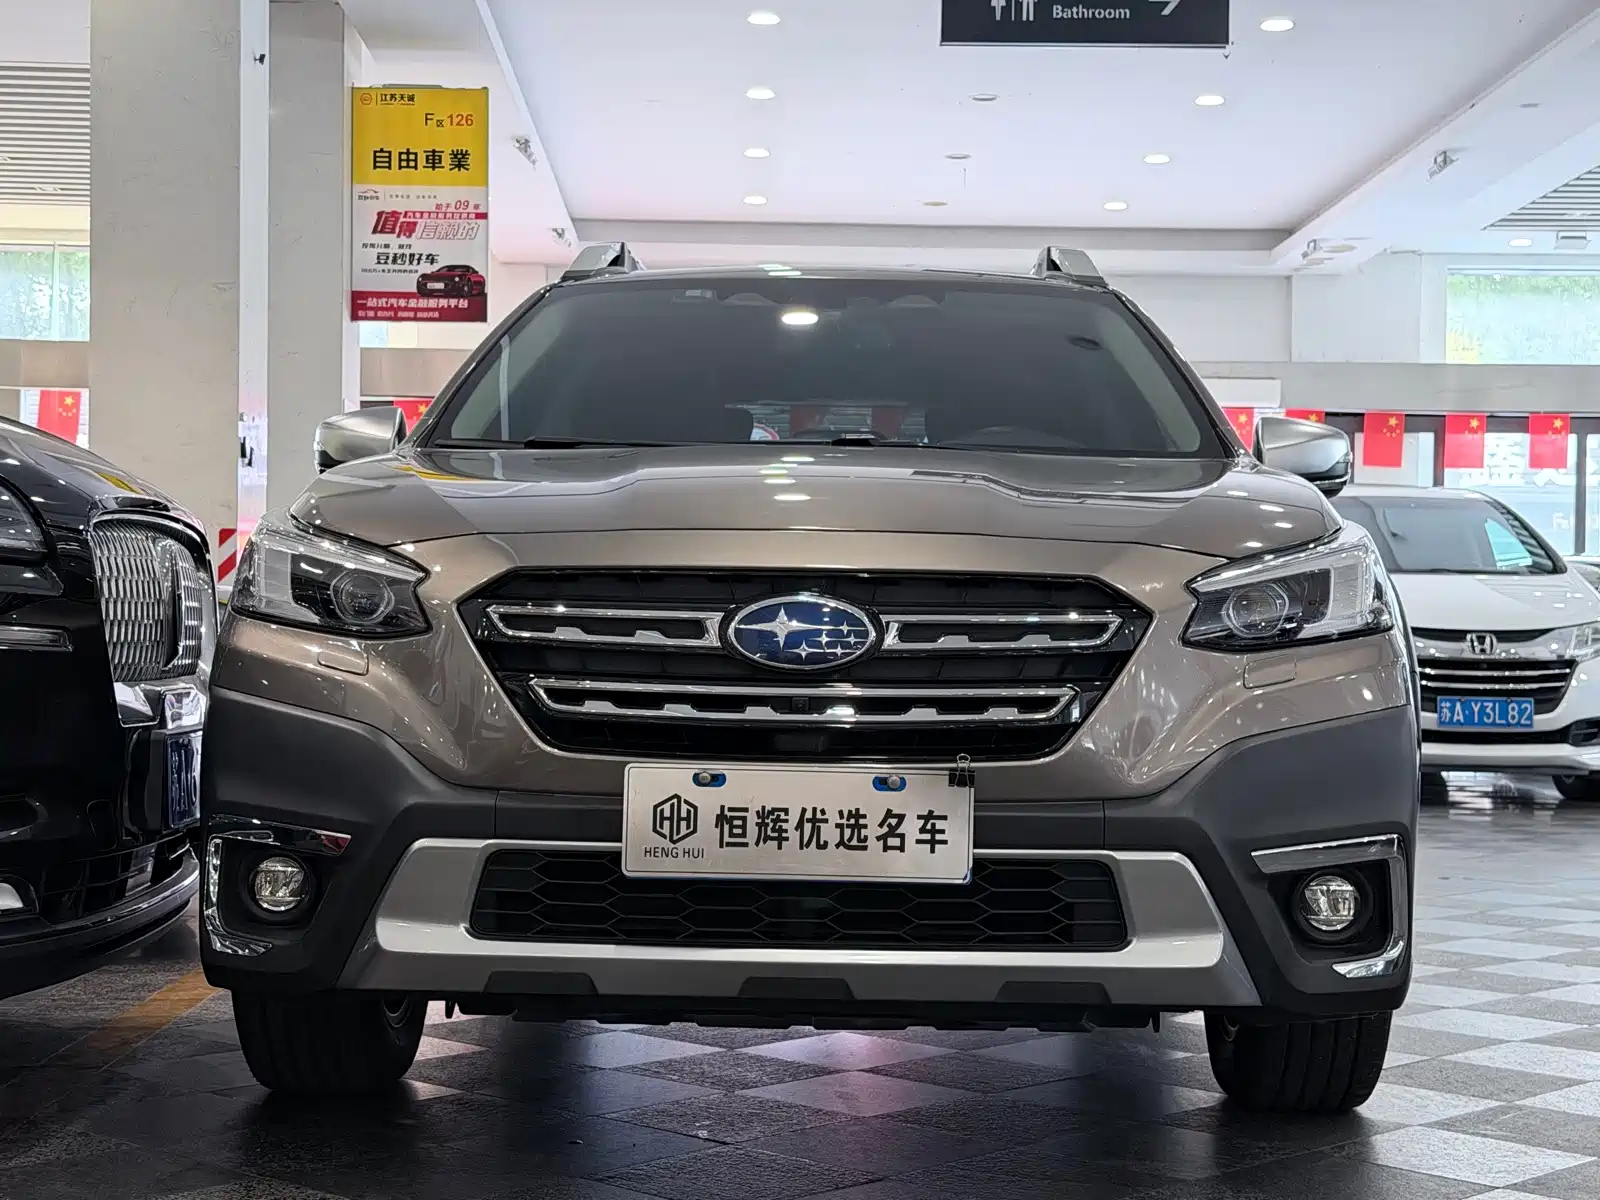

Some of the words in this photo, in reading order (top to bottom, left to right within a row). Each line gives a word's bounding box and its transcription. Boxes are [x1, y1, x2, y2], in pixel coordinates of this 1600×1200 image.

[1052, 4, 1130, 19] Bathroom
[372, 148, 471, 172] 自由車業
[375, 252, 440, 265] 豆秒好车
[714, 803, 949, 854] 恒辉优选名车
[644, 847, 679, 859] HENG
[682, 847, 705, 859] HUI
